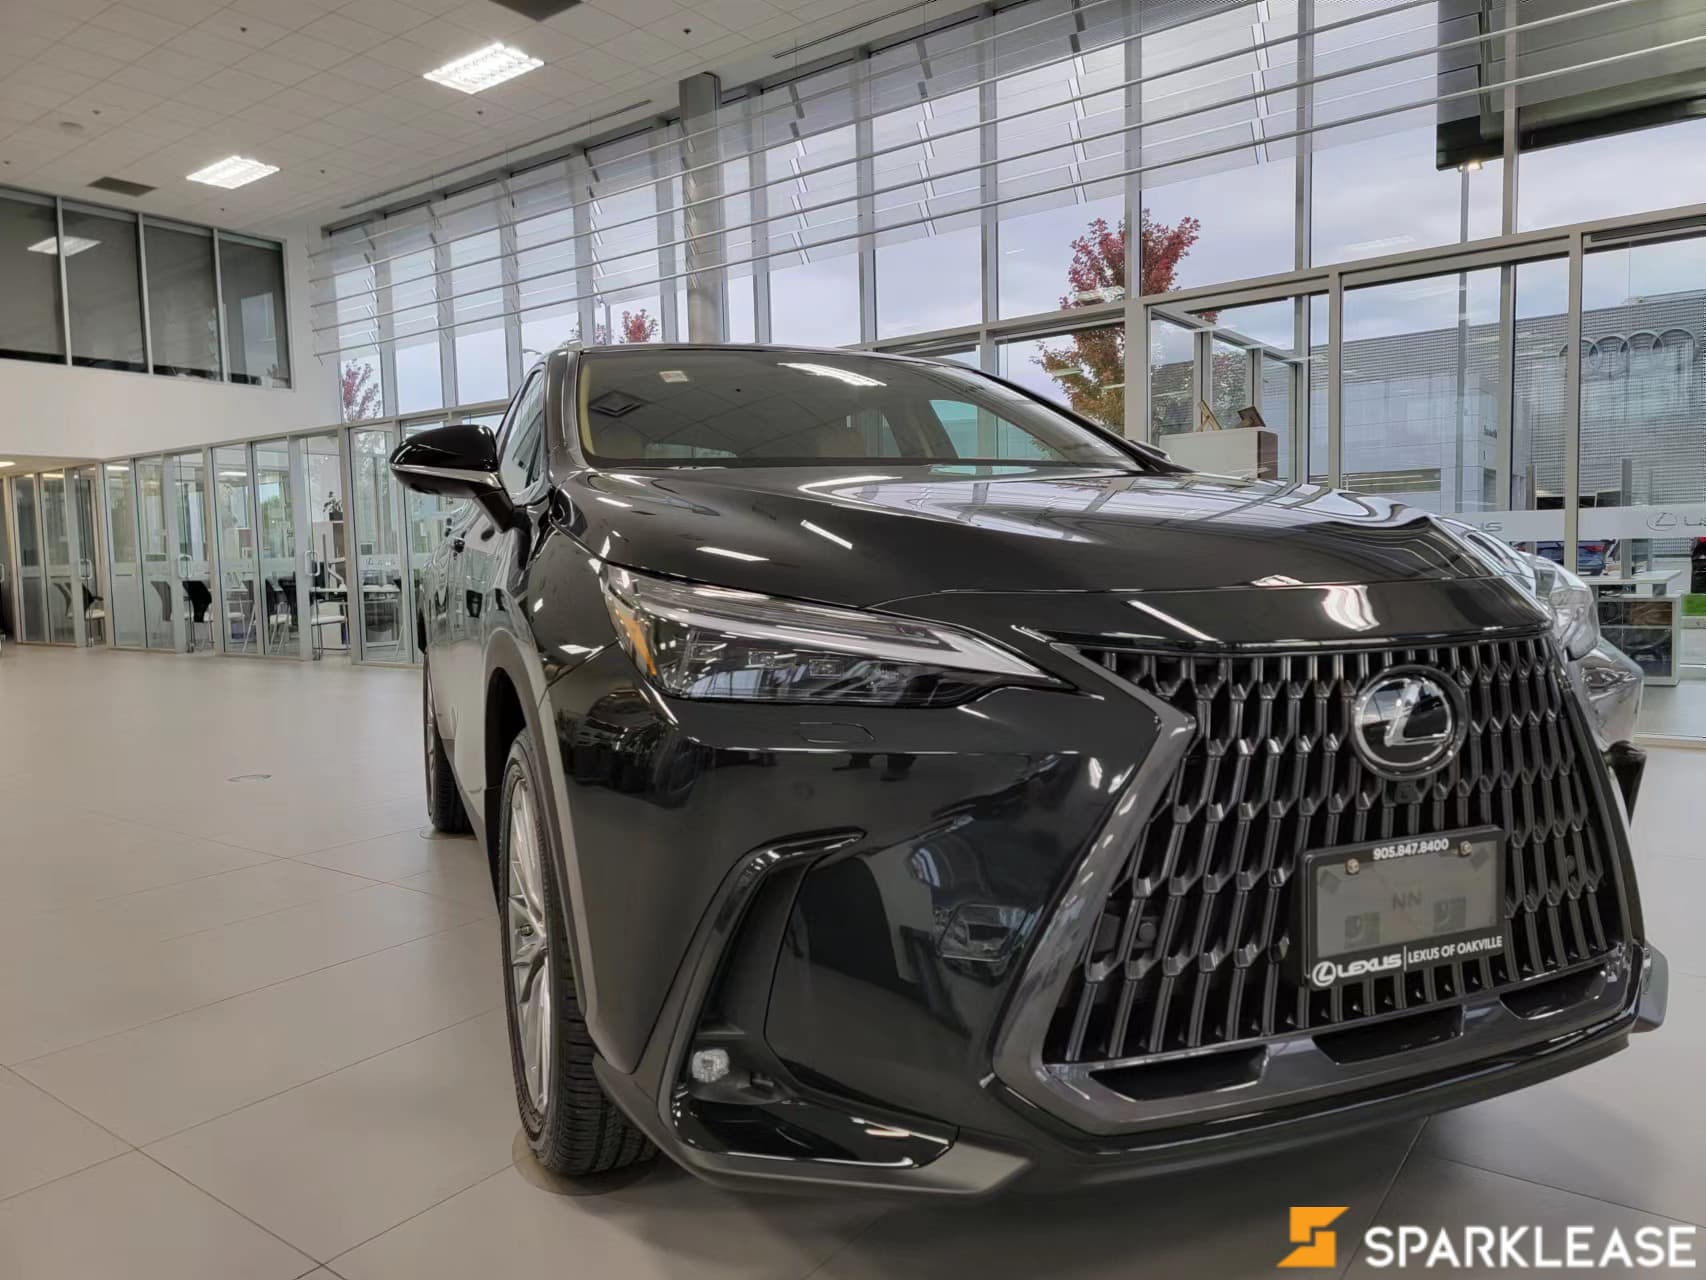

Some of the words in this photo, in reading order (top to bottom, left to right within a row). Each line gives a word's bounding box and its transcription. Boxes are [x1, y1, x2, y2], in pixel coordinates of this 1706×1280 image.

[1373, 838, 1449, 860] 905.847.8400
[1337, 953, 1402, 978] LEXUS
[1408, 946, 1440, 964] LEXUS
[1441, 943, 1455, 958] OF
[1457, 935, 1503, 954] OAKVILLE
